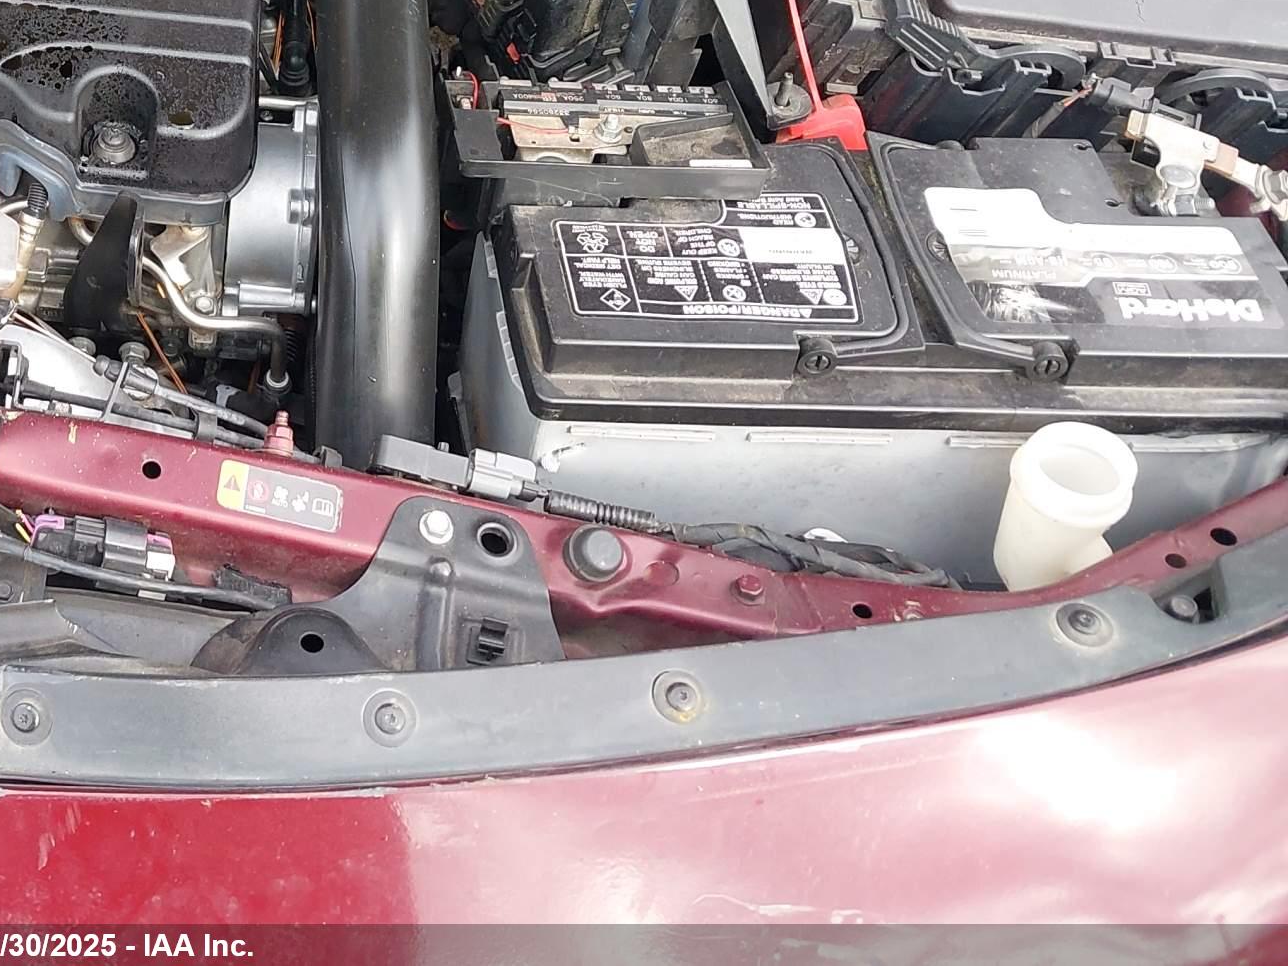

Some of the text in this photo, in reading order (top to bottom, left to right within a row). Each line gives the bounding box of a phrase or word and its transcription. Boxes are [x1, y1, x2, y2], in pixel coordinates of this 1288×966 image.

[635, 238, 656, 246] NOT
[992, 268, 1056, 280] PLATINUM
[682, 305, 800, 318] DANGER/POISON
[1118, 296, 1264, 322] DieHard
